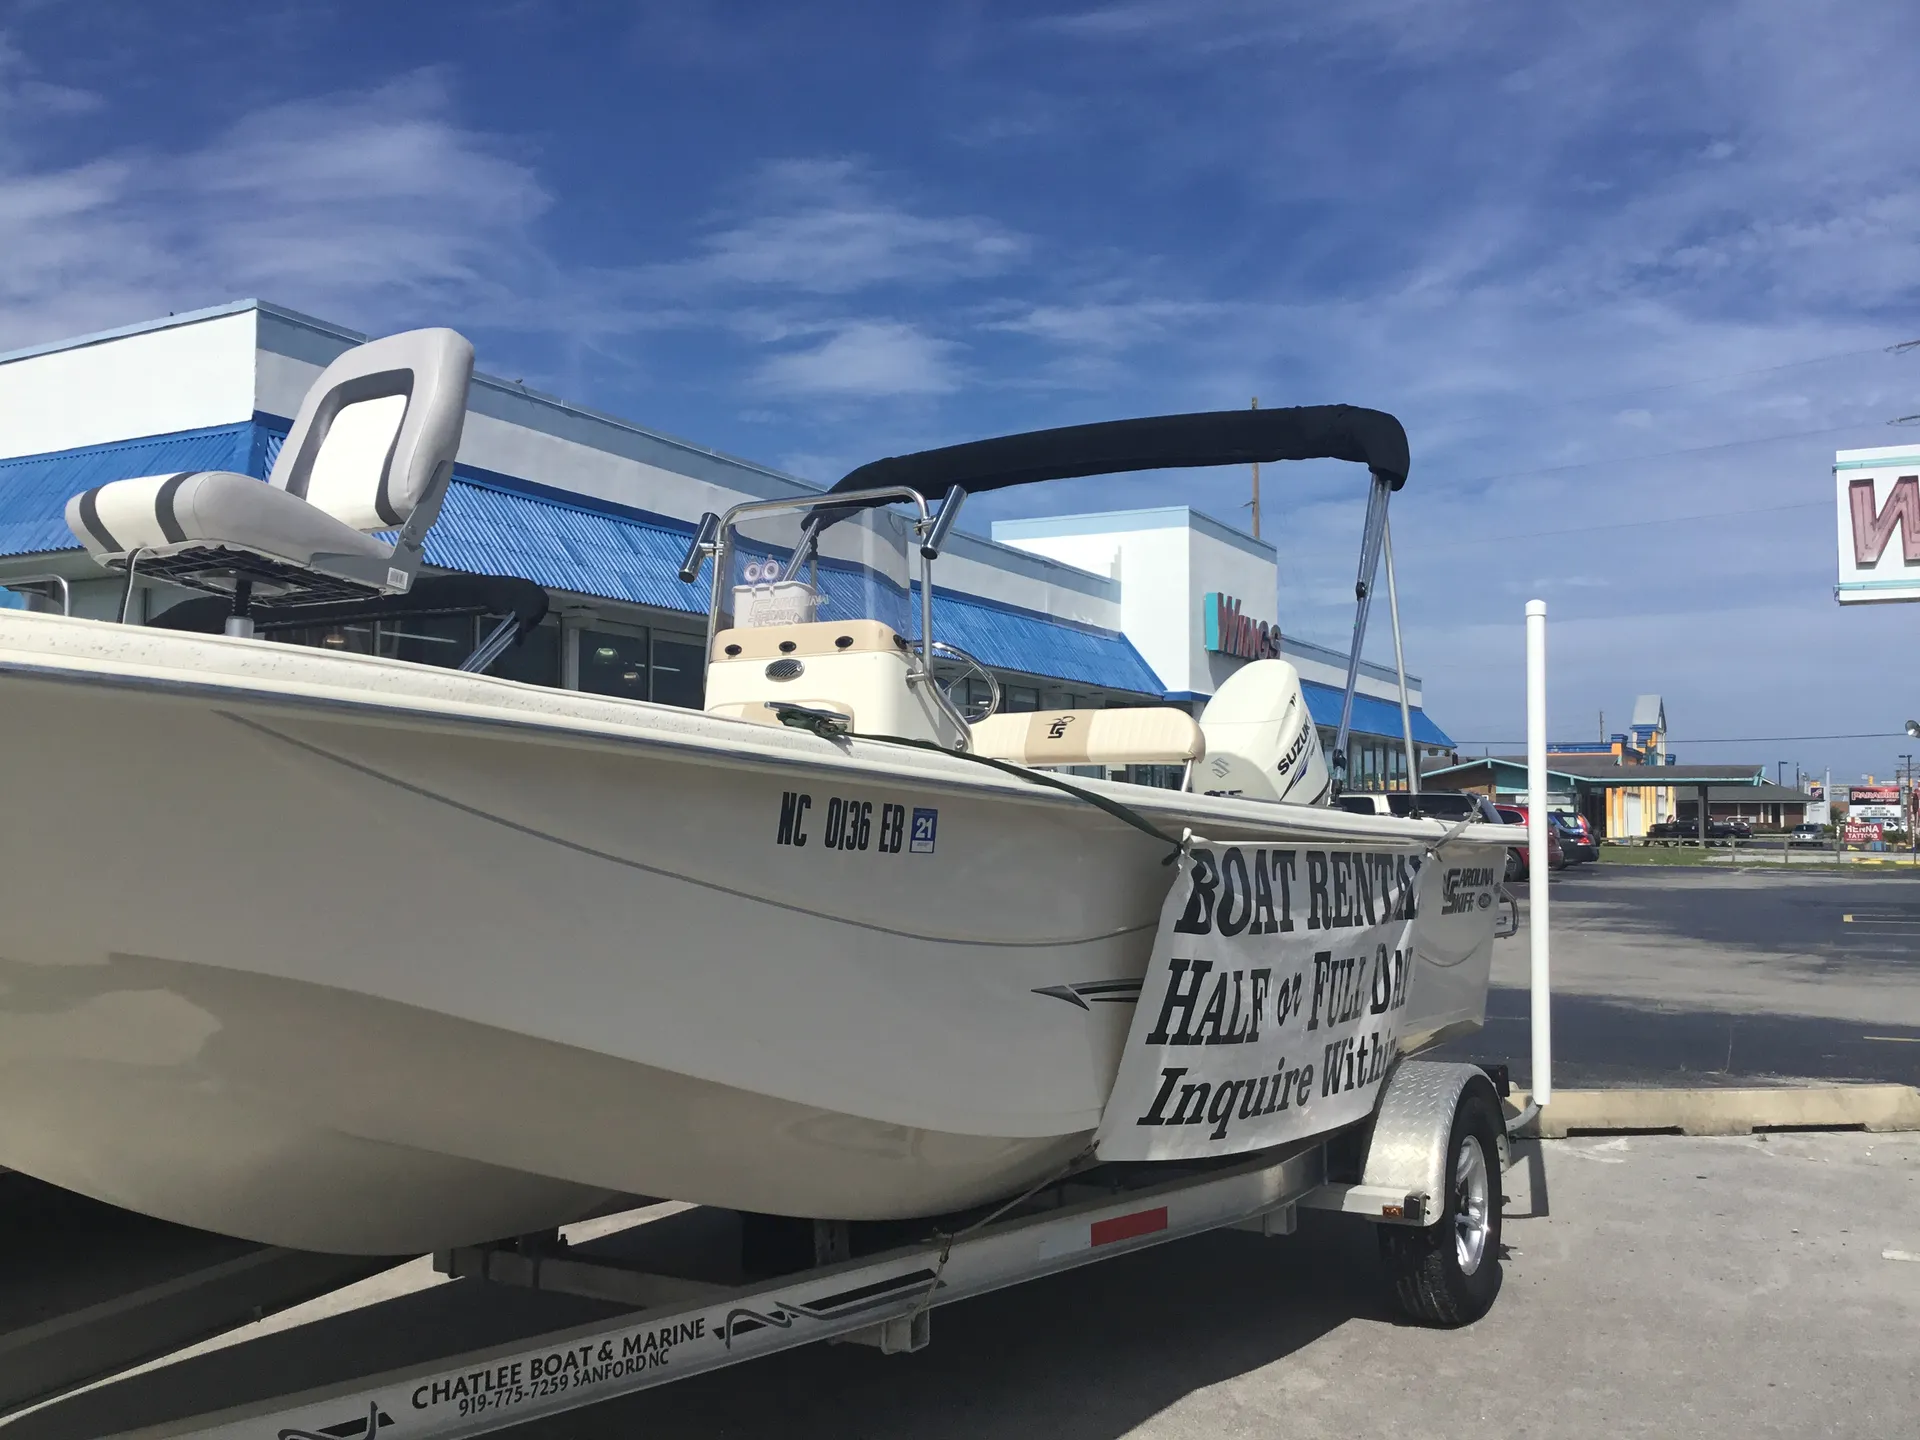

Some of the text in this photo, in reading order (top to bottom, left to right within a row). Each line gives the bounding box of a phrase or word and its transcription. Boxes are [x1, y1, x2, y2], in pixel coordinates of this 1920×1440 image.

[1217, 592, 1281, 661] WINGS
[1277, 714, 1312, 776] SUZUKI
[777, 792, 905, 853] NC 0136 EB
[915, 817, 933, 838] 21
[1845, 825, 1879, 833] HENNA
[1174, 847, 1296, 937] BOAT
[1443, 868, 1494, 896] CAROLINA
[1145, 958, 1271, 1046] HALF
[1307, 951, 1366, 1031] FULL
[1370, 943, 1413, 1015] DAY
[1136, 1057, 1314, 1141] Inquire
[411, 1318, 706, 1410] CHATLEE BOAT & MARINE
[458, 1348, 669, 1417] 919-775-7259 SANFORD NC
